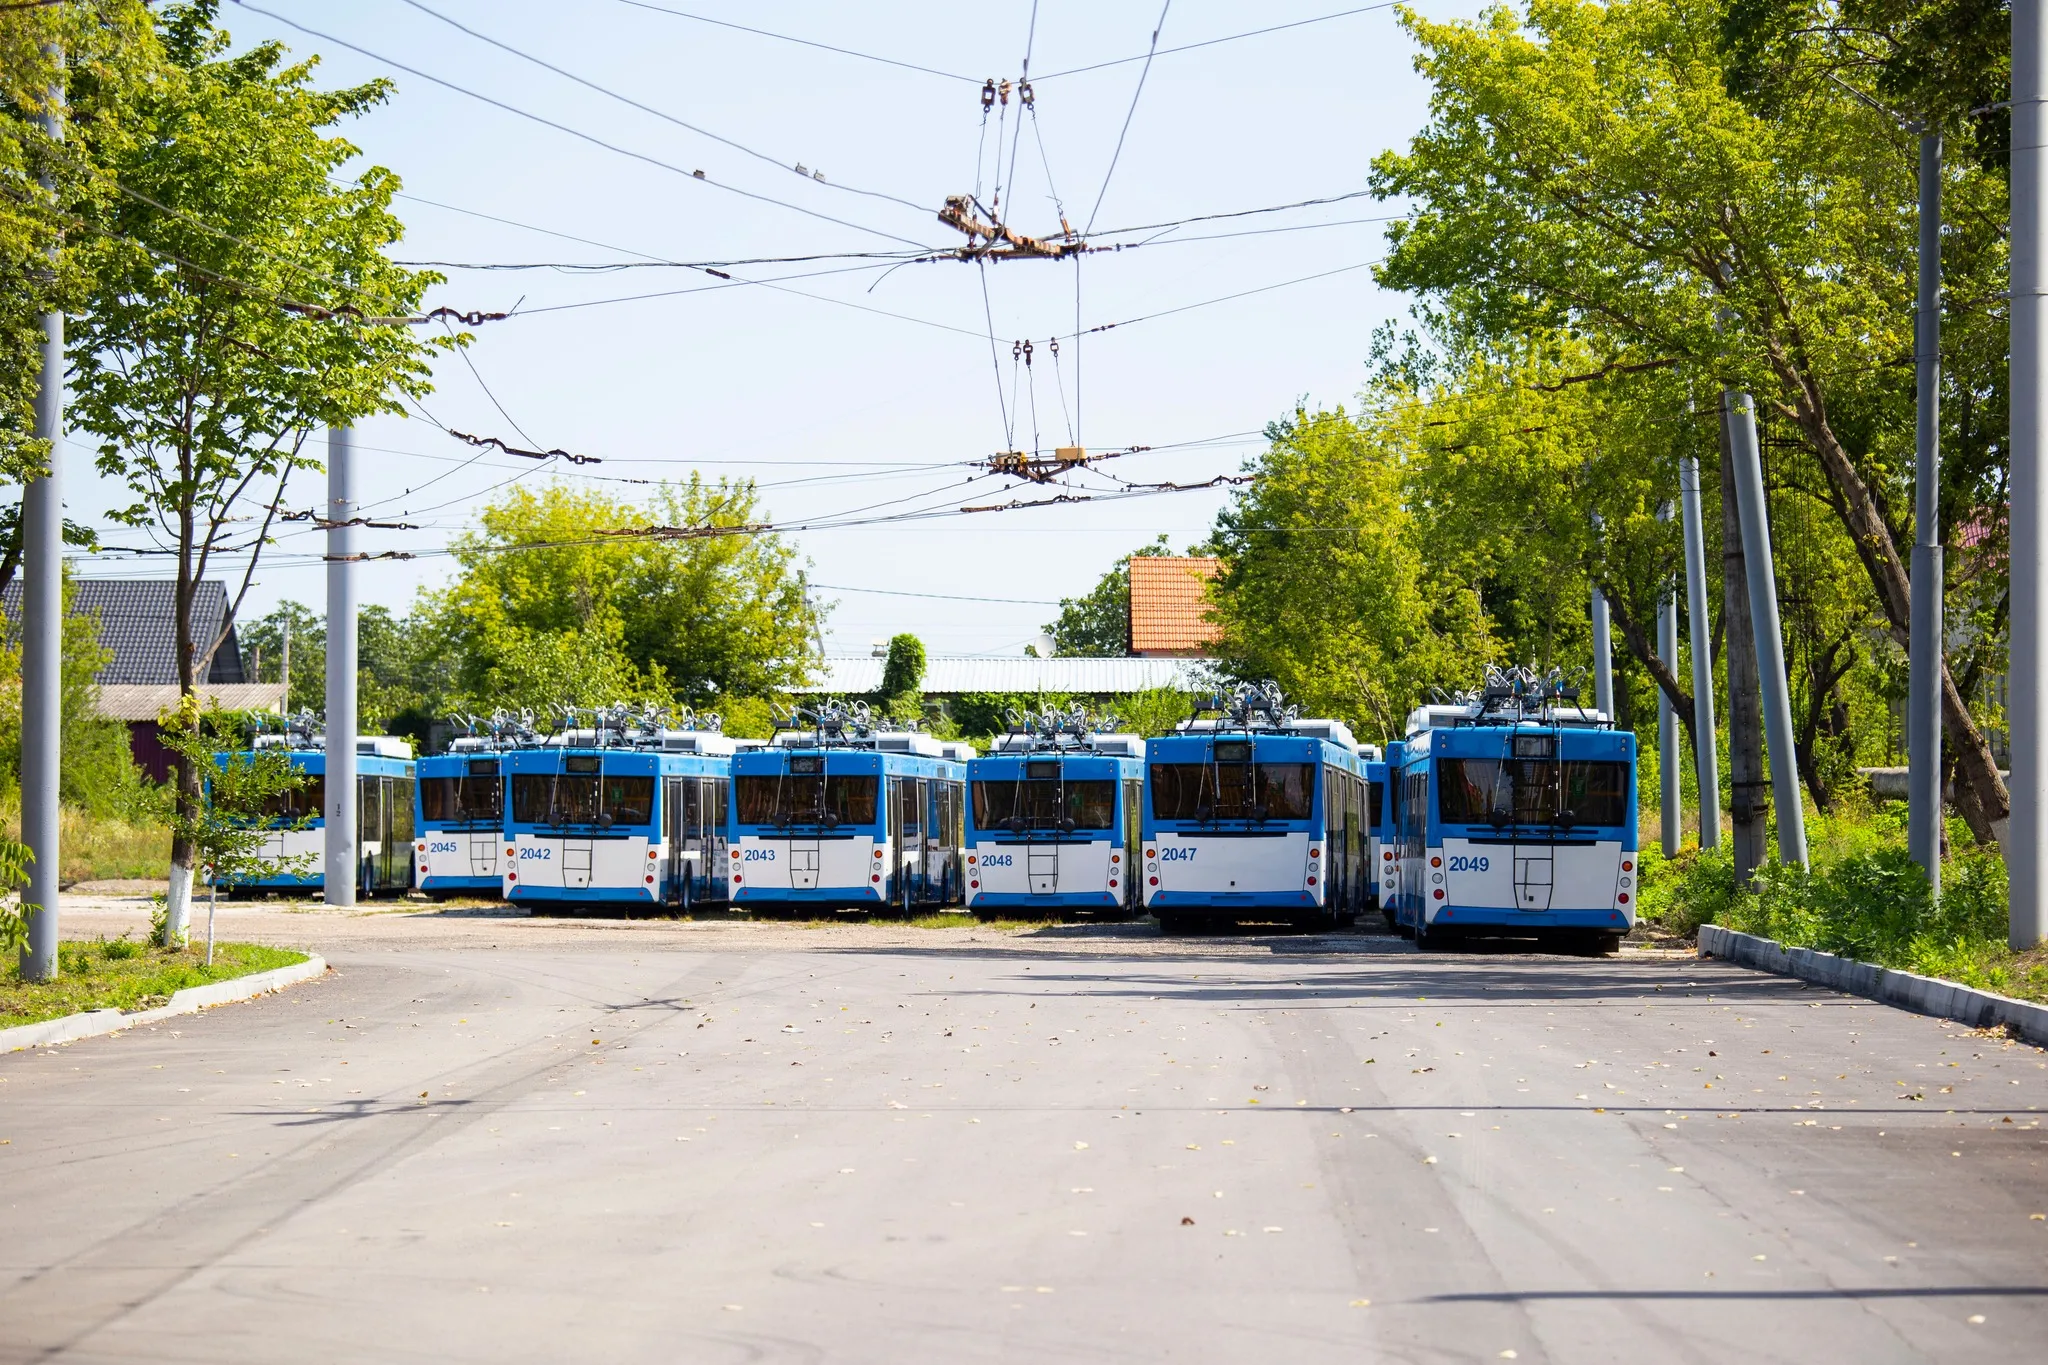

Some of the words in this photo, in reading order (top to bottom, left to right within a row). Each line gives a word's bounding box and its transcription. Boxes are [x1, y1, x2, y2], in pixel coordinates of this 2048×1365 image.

[430, 842, 457, 853] 2045
[519, 847, 551, 860] 2042
[1161, 847, 1197, 861] 2047
[744, 849, 776, 861] 2043
[981, 854, 1013, 867] 2048
[1449, 856, 1489, 872] 2049
